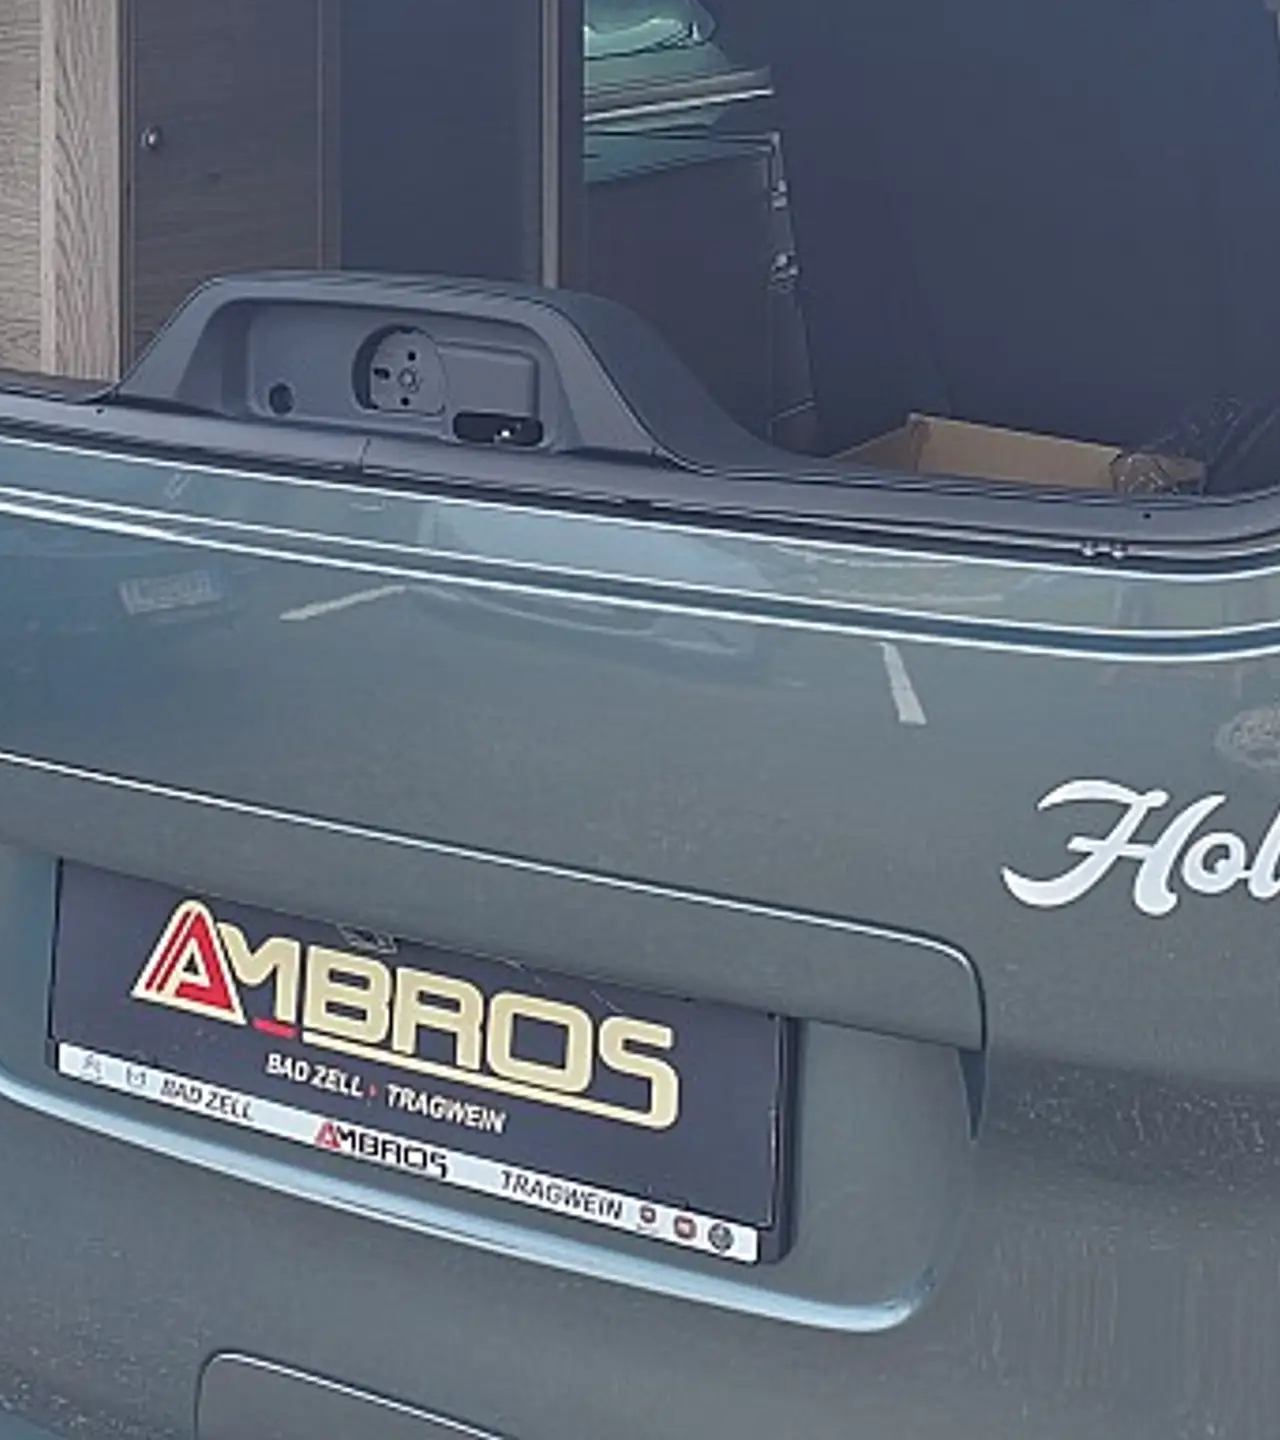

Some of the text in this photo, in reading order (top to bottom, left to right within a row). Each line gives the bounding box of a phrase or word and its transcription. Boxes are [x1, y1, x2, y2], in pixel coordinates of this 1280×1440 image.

[130, 899, 680, 1131] AMBROS
[159, 1077, 624, 1221] BAD ZELL AMBROS TRAGWEIN
[265, 1052, 507, 1135] BAD ZELL TRAGWEIN
